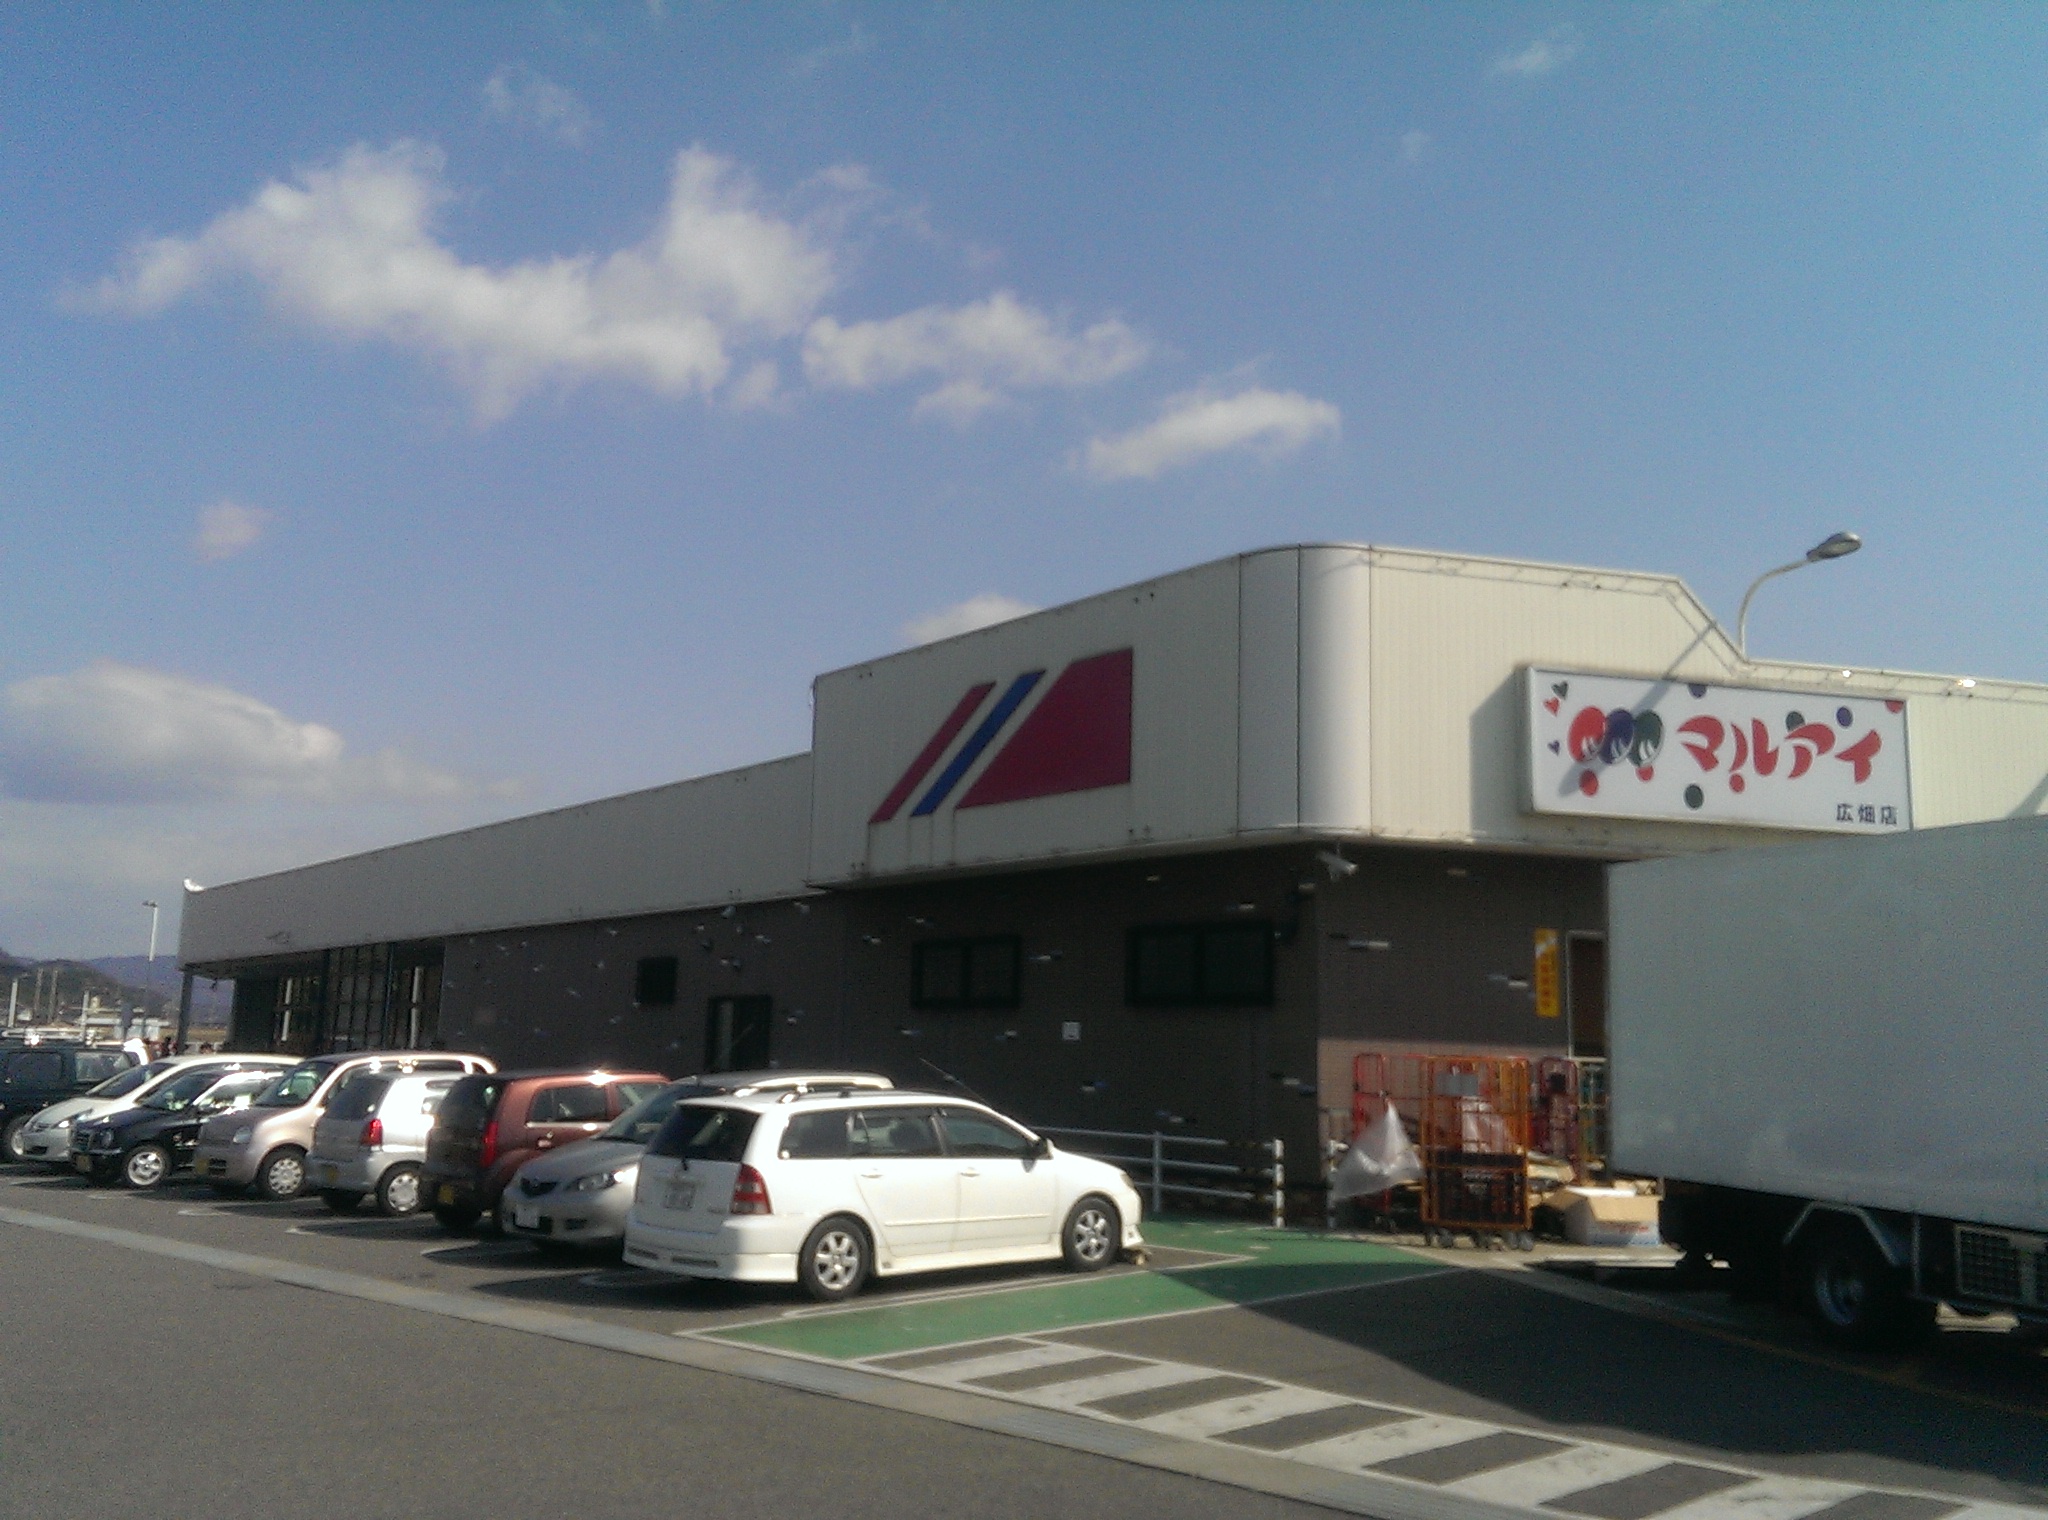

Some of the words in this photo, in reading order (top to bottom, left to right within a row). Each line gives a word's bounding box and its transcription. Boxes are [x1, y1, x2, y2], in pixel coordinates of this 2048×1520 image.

[1677, 715, 1882, 784] マルアイ
[1836, 803, 1898, 825] 広畑店
